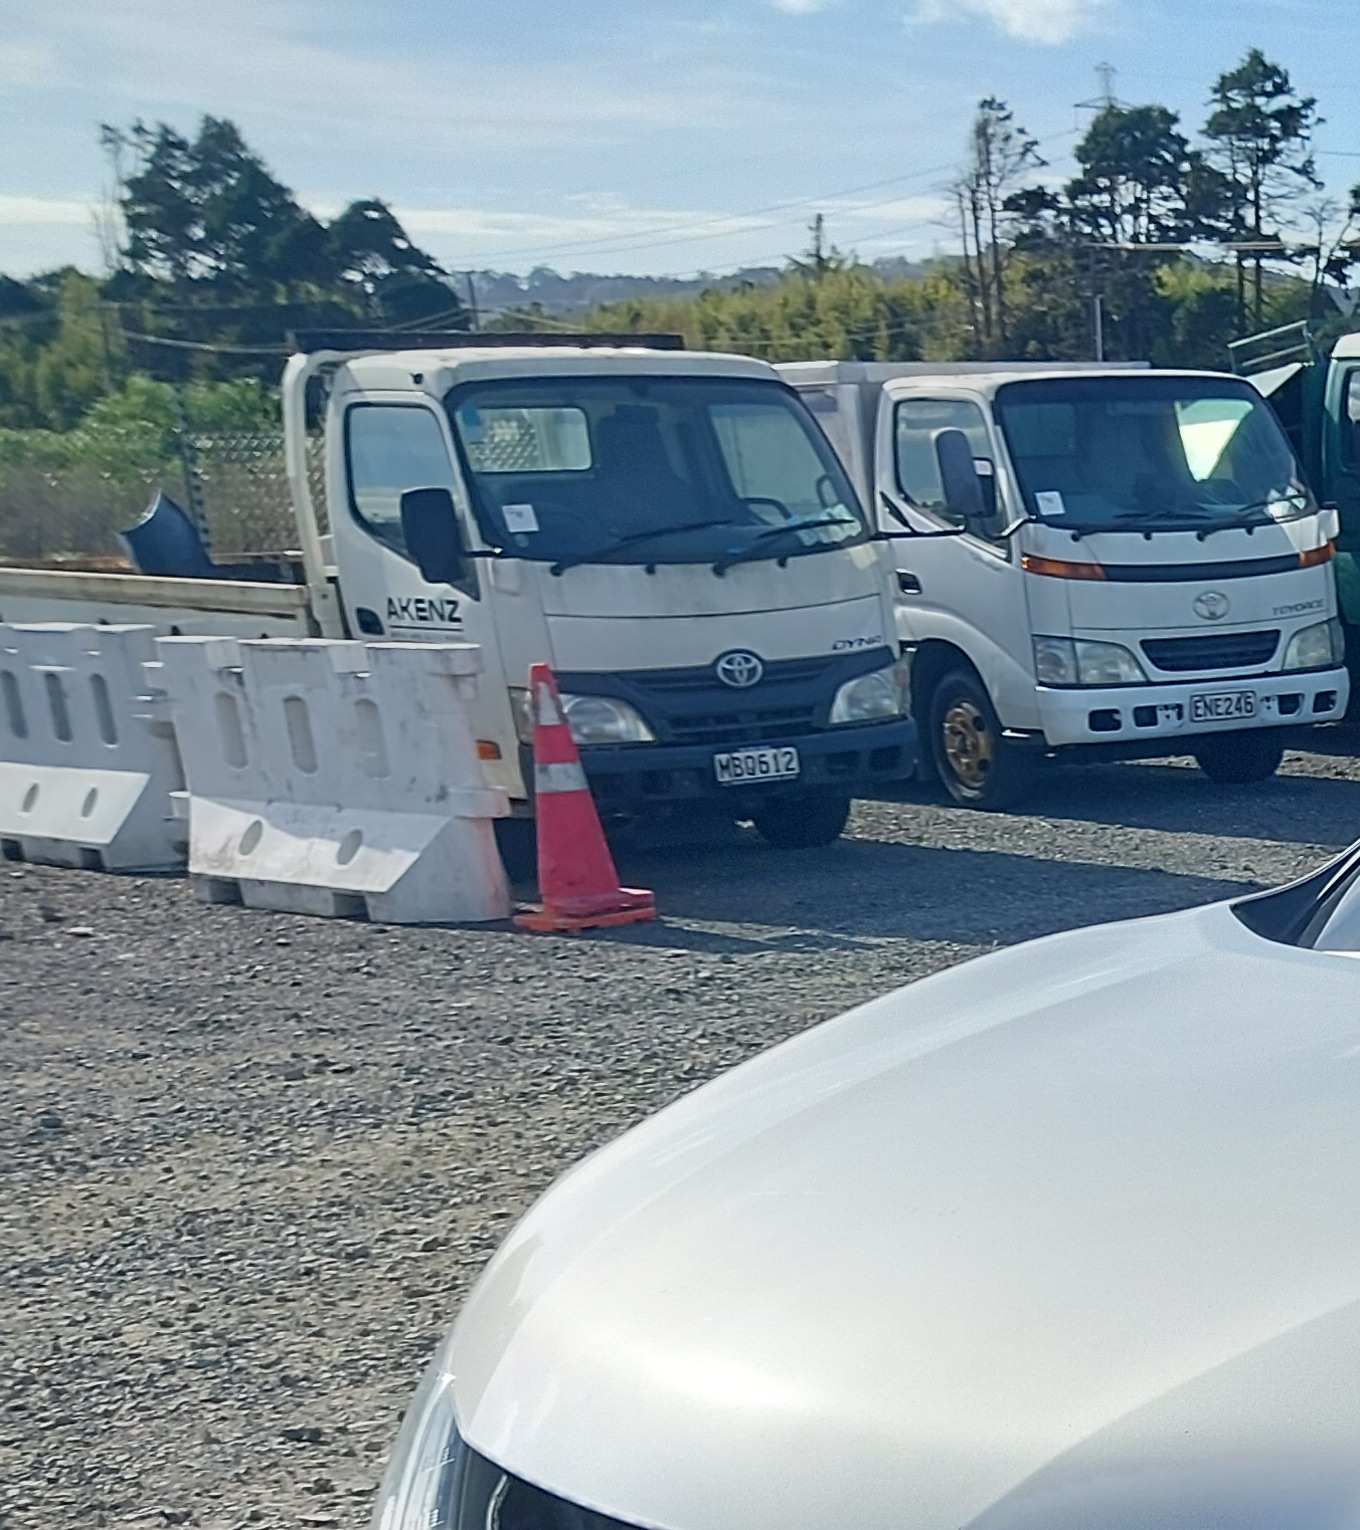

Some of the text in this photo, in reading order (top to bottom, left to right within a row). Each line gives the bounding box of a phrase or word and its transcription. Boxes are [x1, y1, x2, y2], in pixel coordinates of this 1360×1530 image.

[386, 597, 463, 623] AKENZ
[1193, 692, 1254, 718] ENE246
[717, 750, 797, 778] MBQ612
